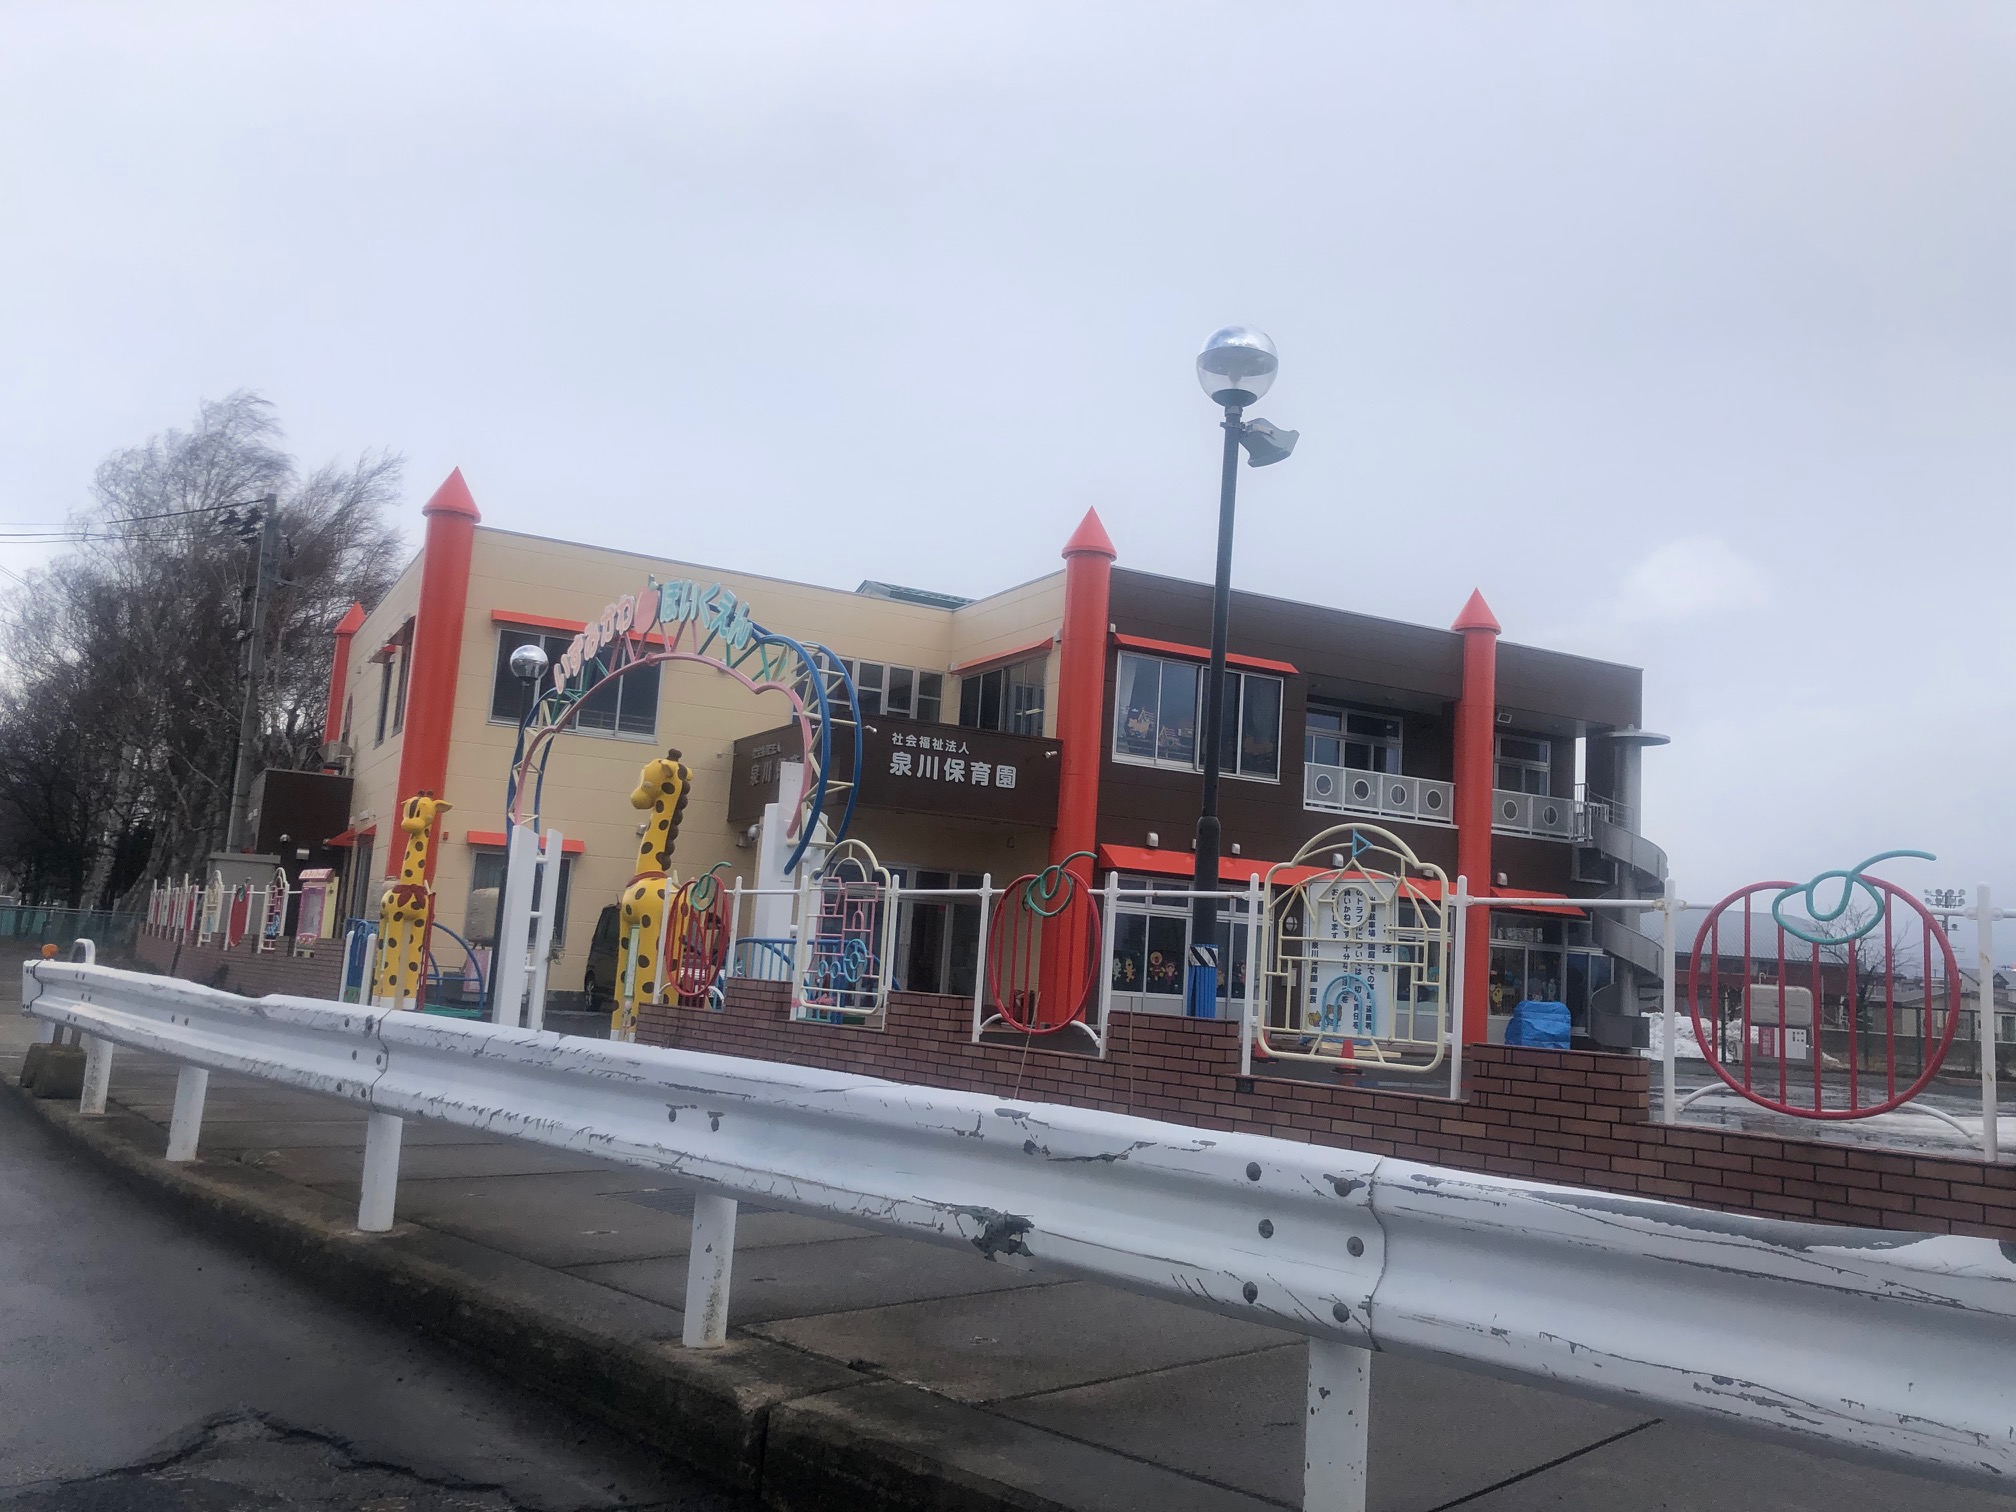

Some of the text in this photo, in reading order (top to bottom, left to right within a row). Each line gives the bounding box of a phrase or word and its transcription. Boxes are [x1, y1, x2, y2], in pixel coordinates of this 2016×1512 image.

[553, 578, 754, 694] いずみかわ ほいくえん
[891, 732, 970, 755] 社会福祉法人
[889, 751, 1017, 789] 泉川保育園
